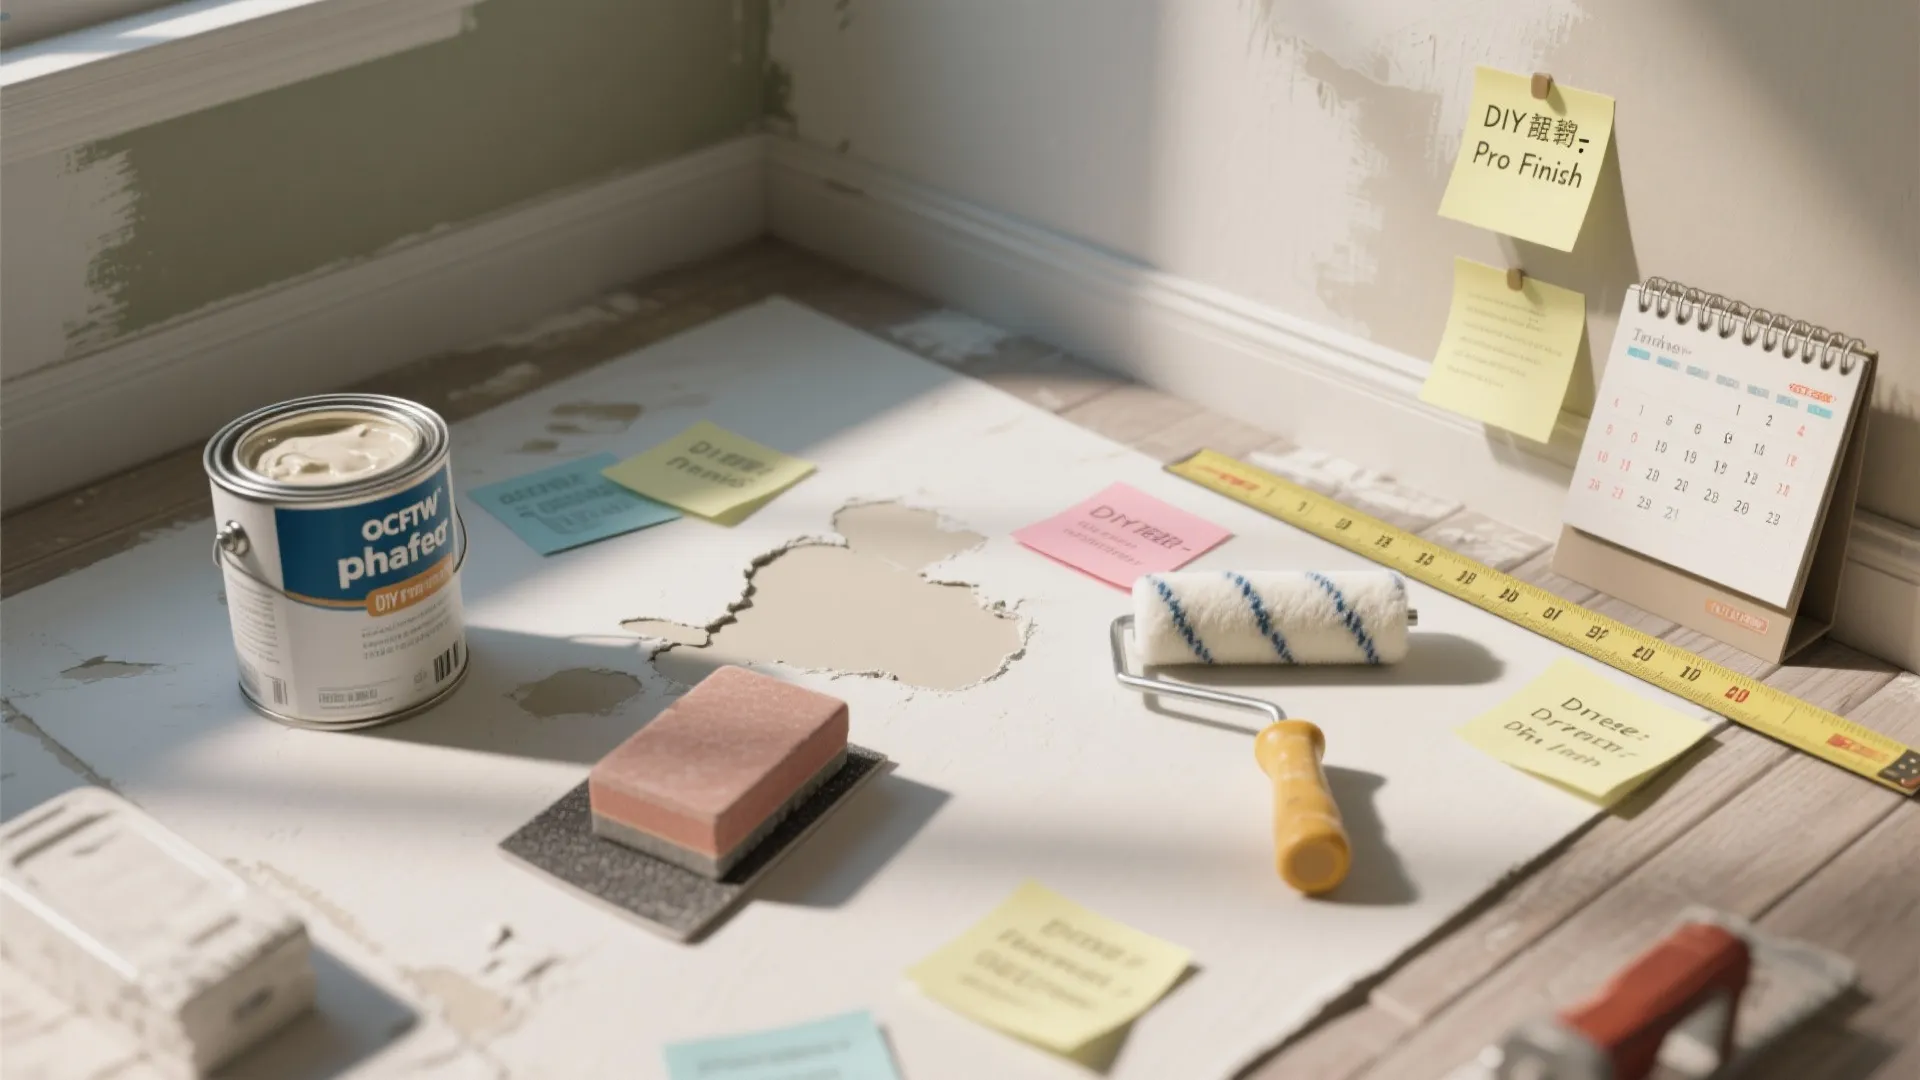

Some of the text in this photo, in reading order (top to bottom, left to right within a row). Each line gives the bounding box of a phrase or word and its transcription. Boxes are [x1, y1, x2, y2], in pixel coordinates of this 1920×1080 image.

[1483, 104, 1527, 133] DIY
[1473, 140, 1583, 189] Pro Finish
[1765, 414, 1773, 427] 2
